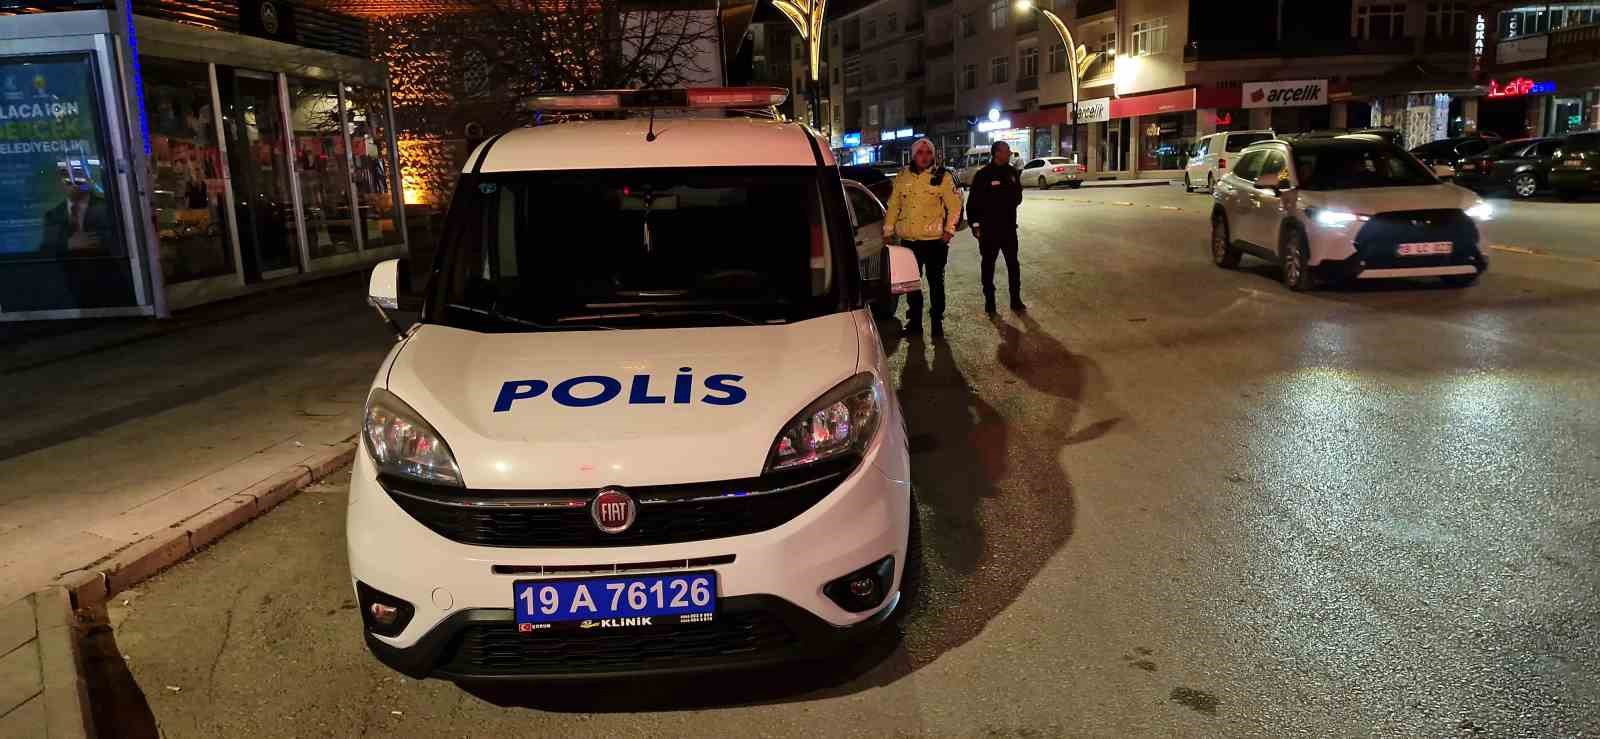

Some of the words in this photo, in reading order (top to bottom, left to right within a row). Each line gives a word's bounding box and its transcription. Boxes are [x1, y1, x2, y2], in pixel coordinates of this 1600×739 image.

[1267, 84, 1321, 105] arçelik
[0, 103, 43, 119] LACA
[0, 140, 81, 154] ELEDİYECİLİK
[601, 501, 627, 522] FIAT
[519, 586, 559, 616] 19
[569, 584, 598, 614] A
[606, 577, 710, 612] 76126
